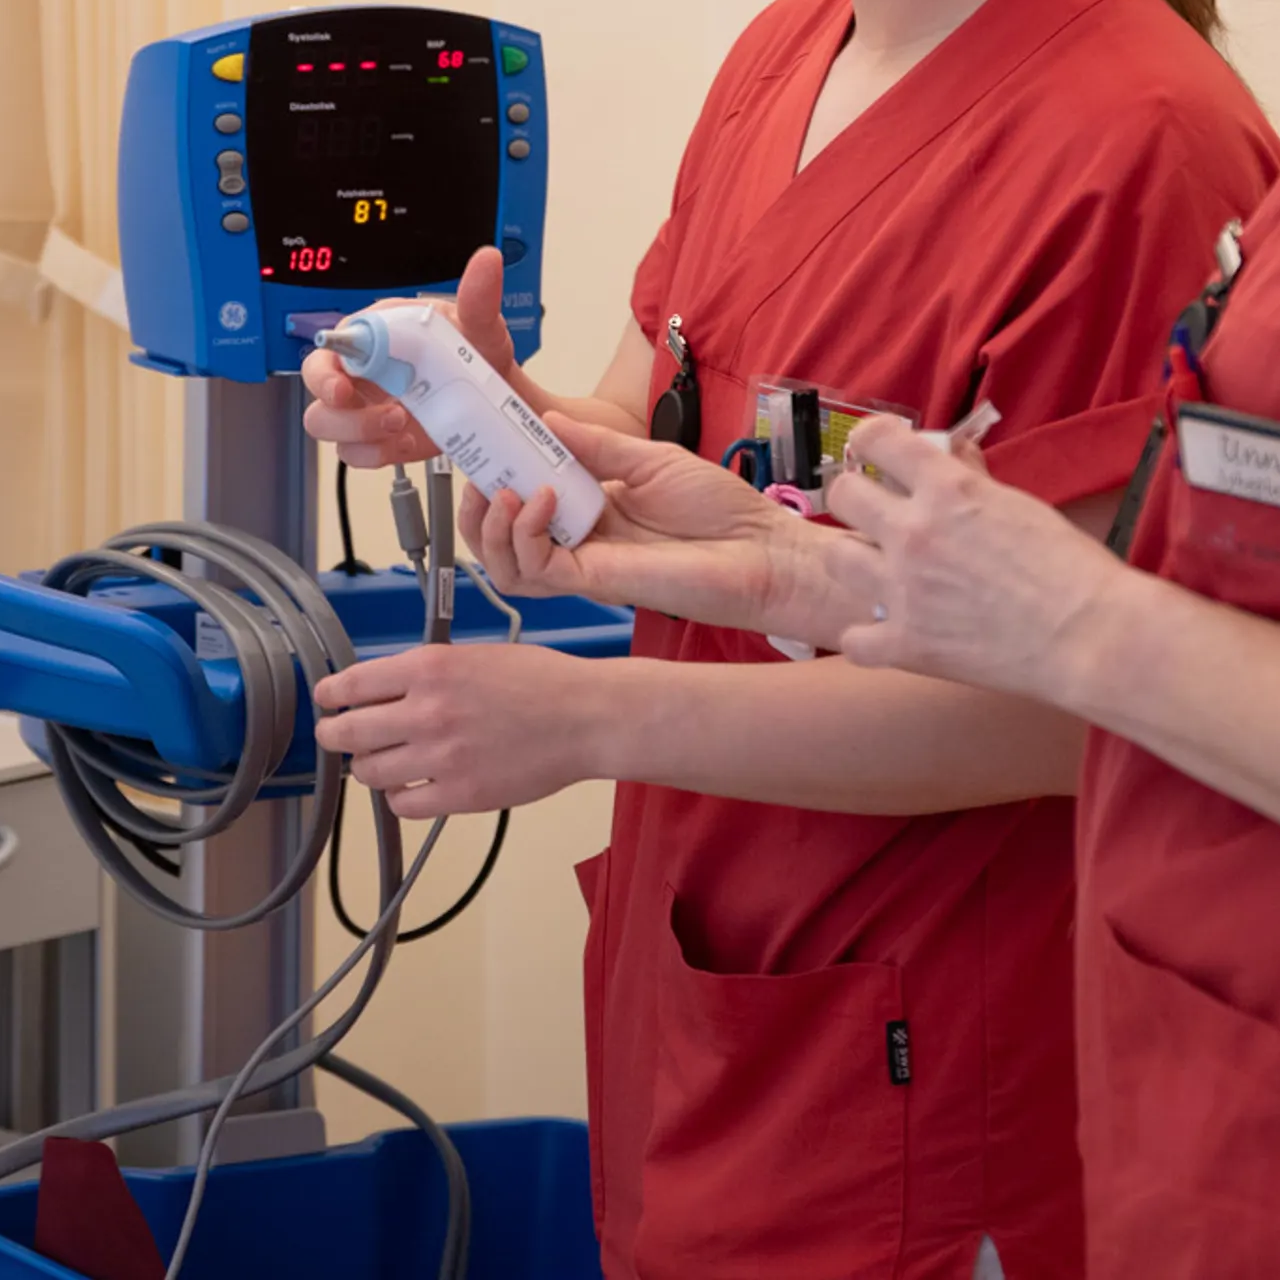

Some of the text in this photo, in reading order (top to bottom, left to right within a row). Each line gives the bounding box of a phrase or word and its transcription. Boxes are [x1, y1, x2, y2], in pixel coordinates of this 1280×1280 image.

[354, 199, 388, 224] 87
[289, 246, 332, 272] 100
[457, 346, 474, 364] 03
